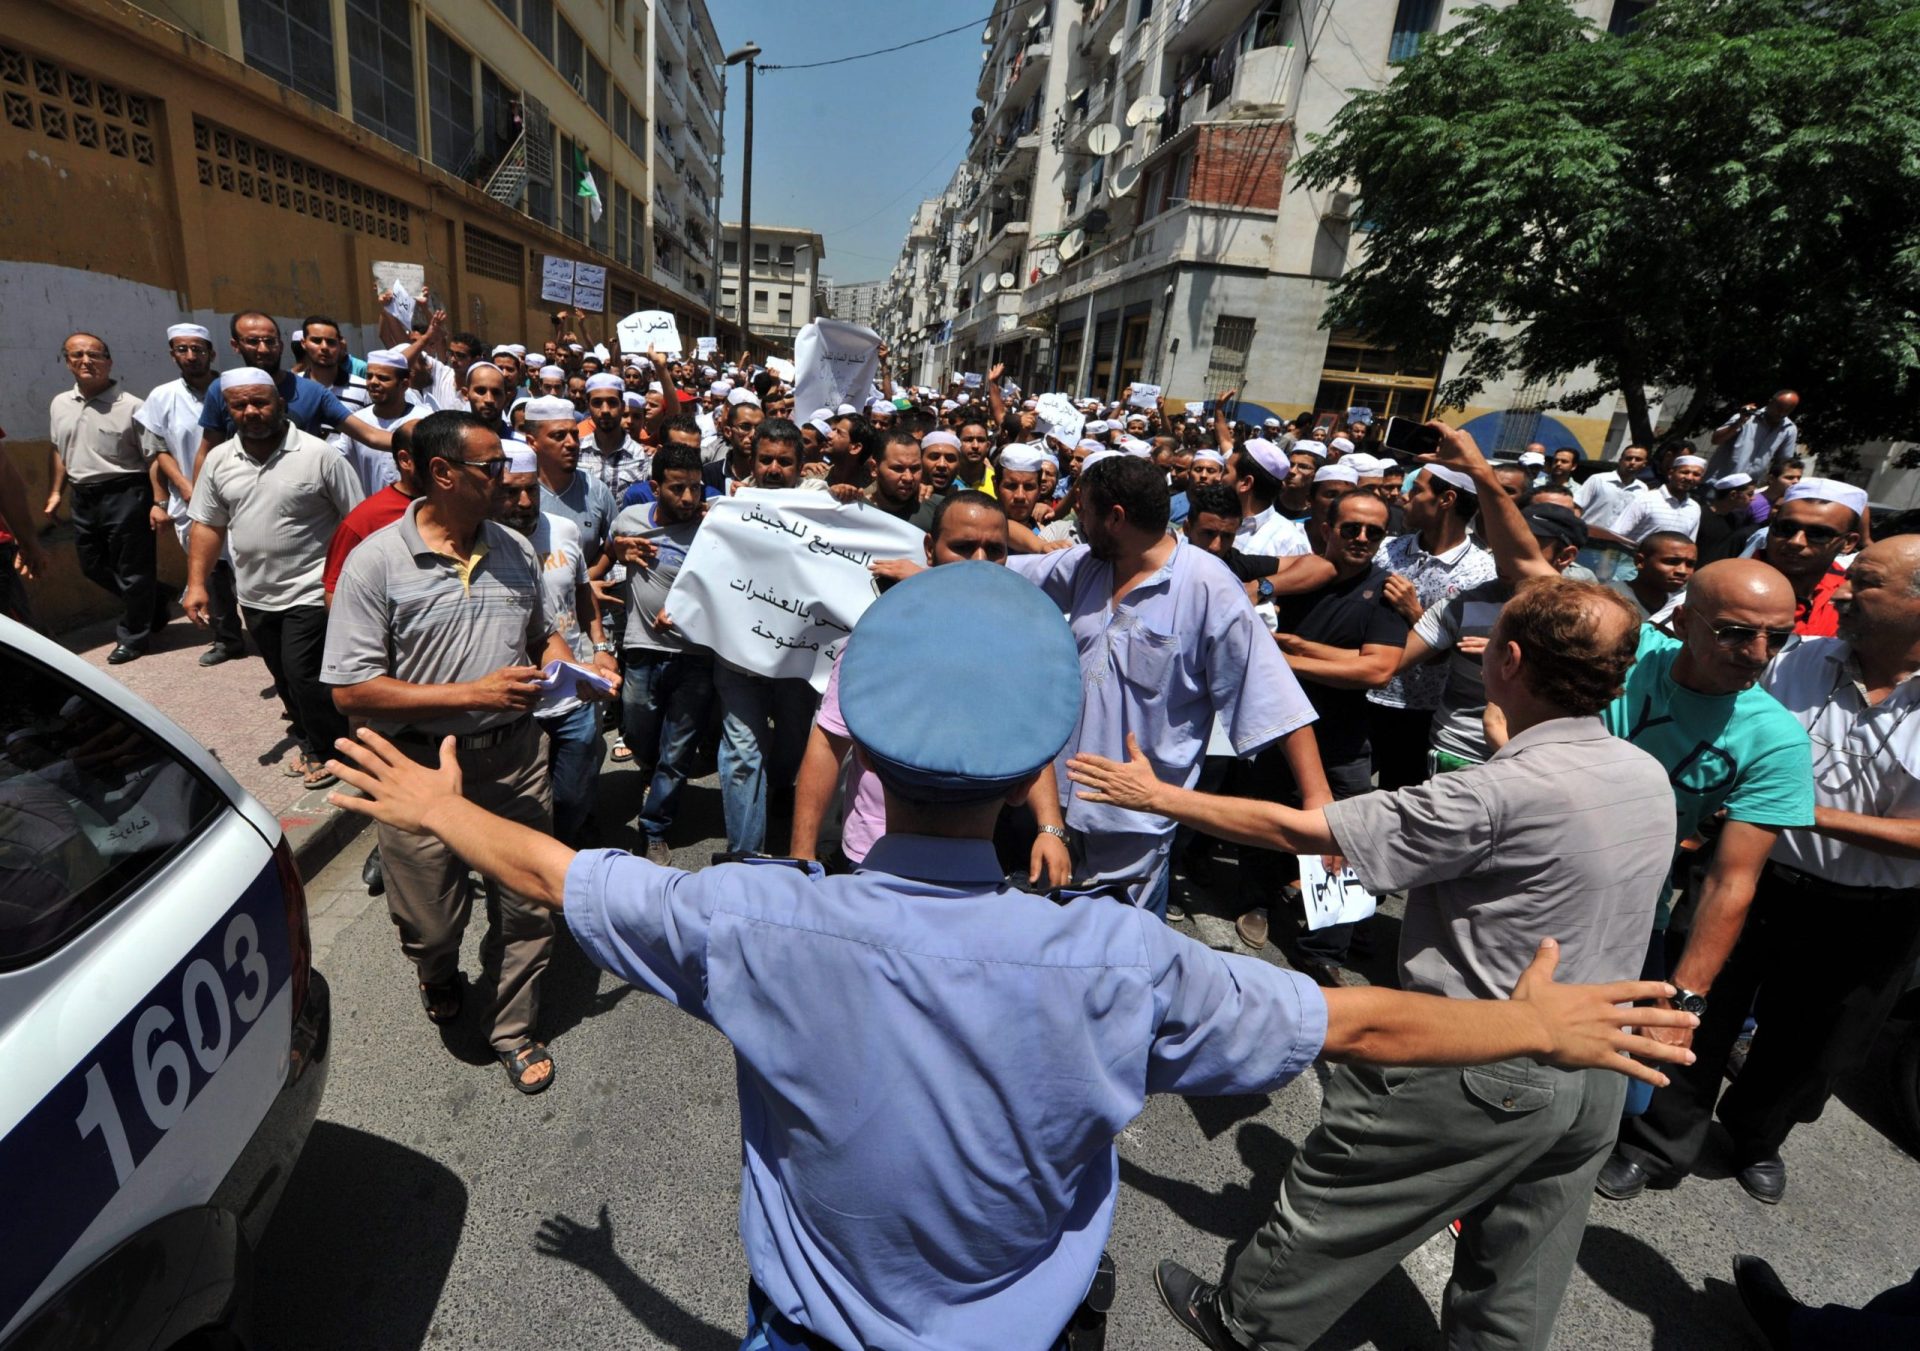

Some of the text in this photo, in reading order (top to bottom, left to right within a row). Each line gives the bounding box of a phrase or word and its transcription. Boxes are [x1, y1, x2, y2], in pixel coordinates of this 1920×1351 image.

[623, 316, 673, 334] إضراب
[741, 503, 872, 567] السريع للجيش
[730, 577, 853, 634] حى بالعشرات
[751, 619, 820, 652] مفتوحة
[75, 912, 270, 1189] 1603
